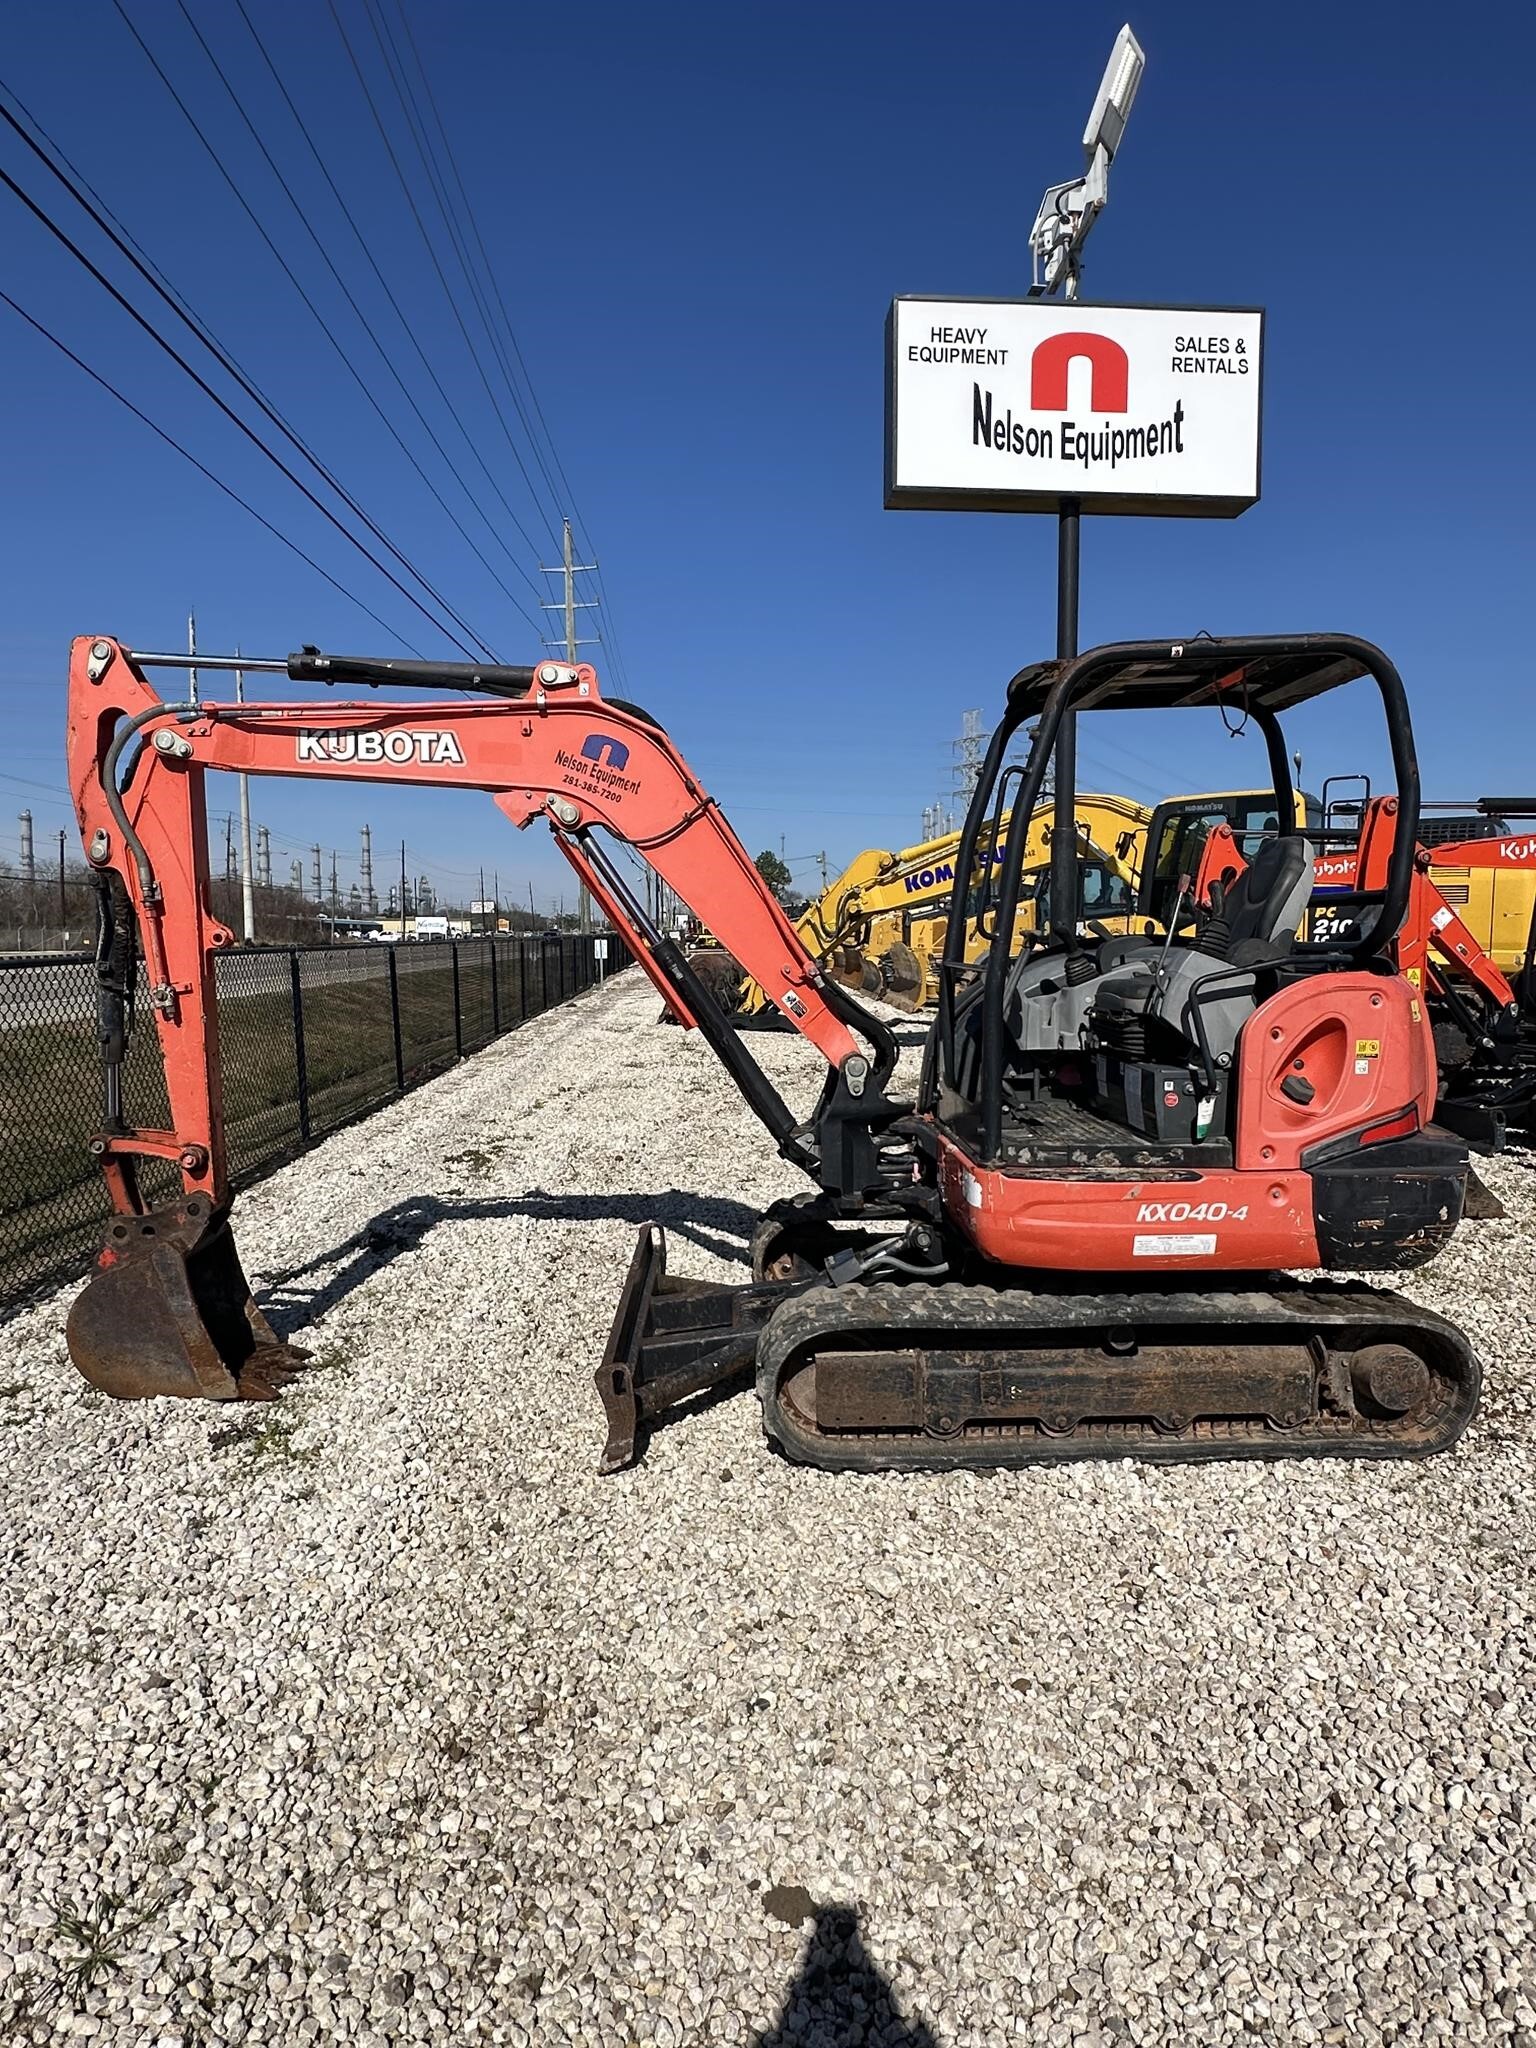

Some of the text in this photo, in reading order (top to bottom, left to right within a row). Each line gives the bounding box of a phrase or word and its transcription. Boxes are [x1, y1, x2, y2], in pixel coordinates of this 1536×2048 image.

[930, 326, 988, 345] HEAVY
[1174, 335, 1247, 355] SALES &
[908, 345, 1008, 366] EQUIPMENT
[1171, 356, 1249, 375] RENTALS
[972, 382, 1184, 469] Nelson Equipment
[298, 730, 462, 763] KUBOTA
[554, 749, 642, 795] Nelson Equipment
[562, 774, 622, 803] 281-385-7200
[1184, 803, 1224, 812] KOMATSU
[1314, 906, 1337, 918] PC
[1136, 1202, 1249, 1222] KX040-4
